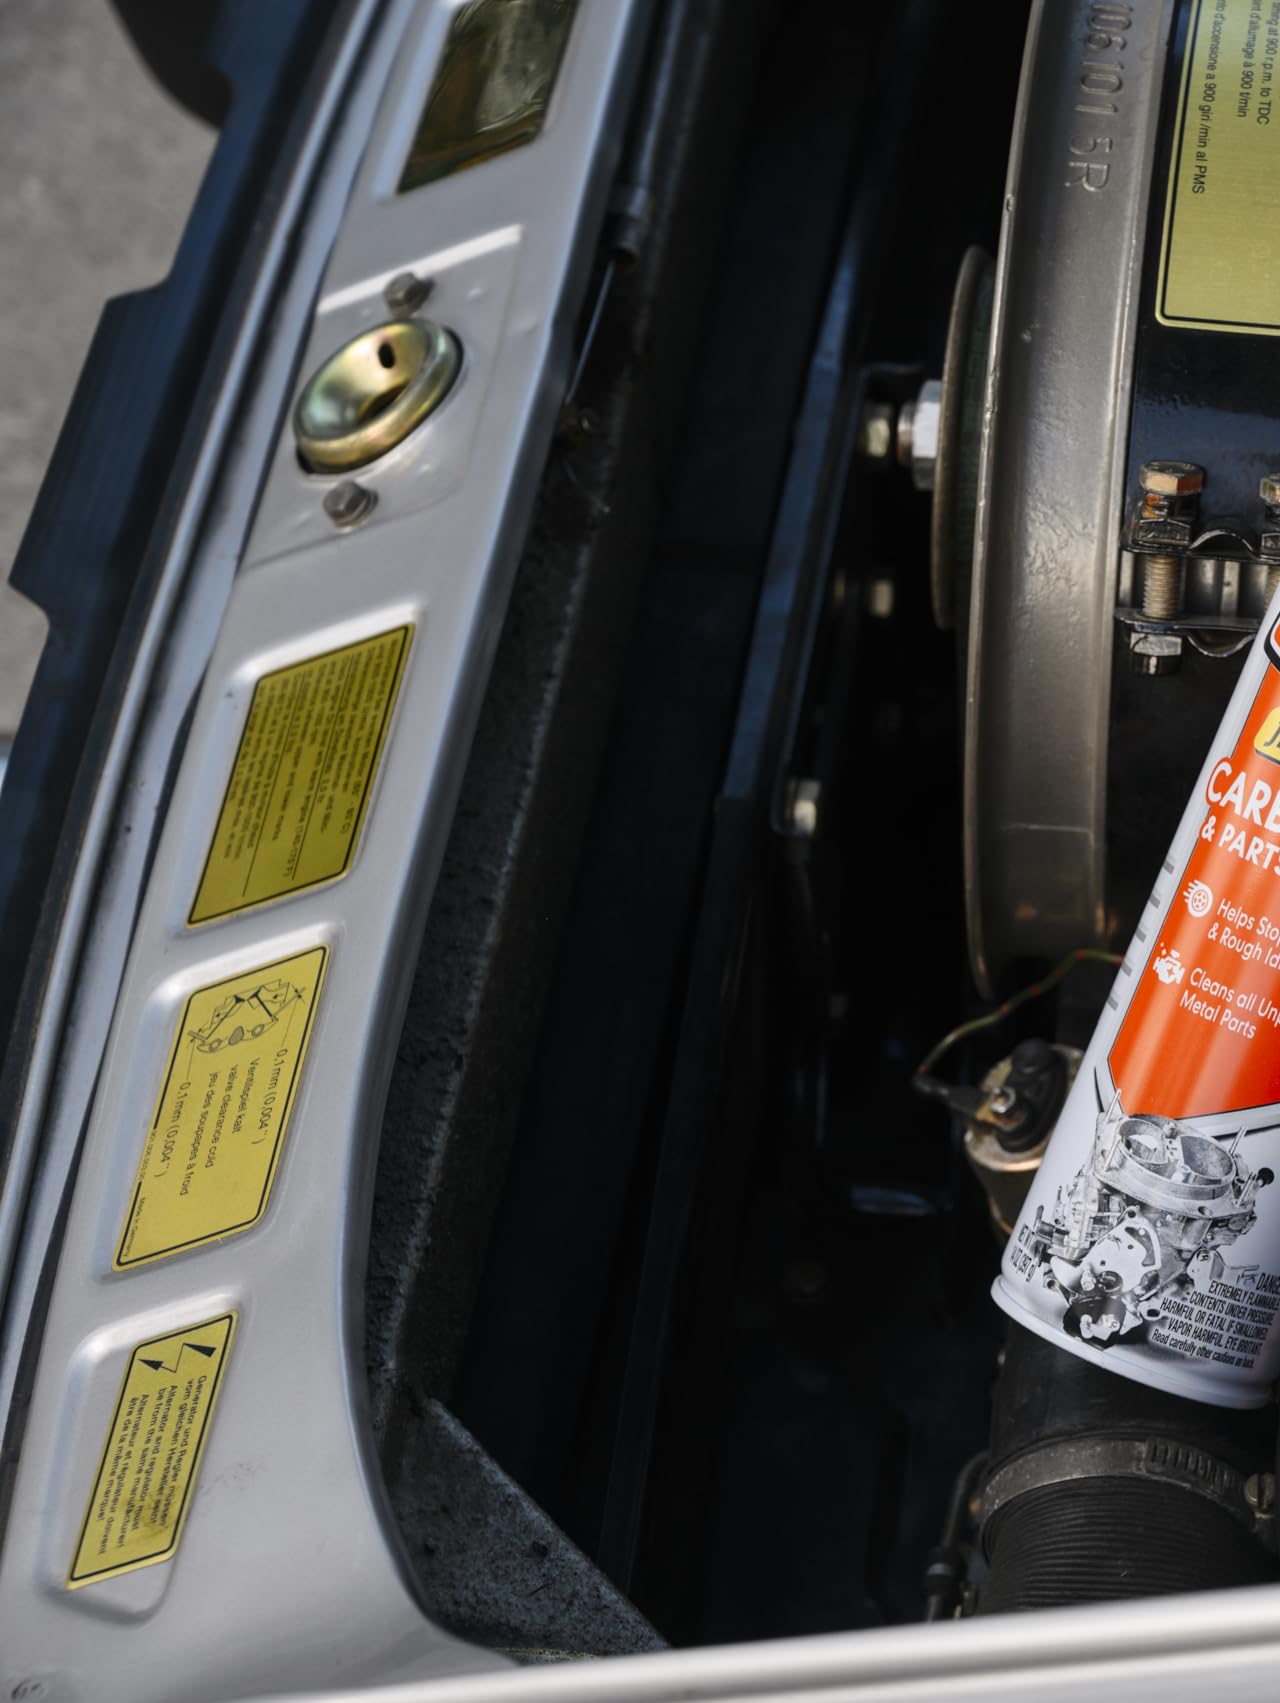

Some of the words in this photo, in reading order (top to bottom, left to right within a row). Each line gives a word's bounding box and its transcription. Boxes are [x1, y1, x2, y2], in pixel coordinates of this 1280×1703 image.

[1264, 38, 1278, 54] 900
[1202, 82, 1217, 102] 900
[1239, 70, 1254, 89] 900
[1259, 87, 1271, 97] to
[1256, 100, 1271, 125] TDC
[1195, 151, 1208, 161] al
[1191, 164, 1207, 194] PMS
[1199, 814, 1219, 842] &
[1216, 897, 1255, 930] Helps
[1206, 922, 1220, 941] &
[1219, 926, 1264, 960] Rough
[1188, 966, 1235, 1002] Cleans
[1236, 988, 1257, 1010] all
[1179, 989, 1220, 1023] Metal
[1219, 1010, 1257, 1039] Parts
[206, 1070, 219, 1088] jeu
[223, 1063, 240, 1093] valve
[235, 1057, 260, 1113] Ventilspiel
[202, 1088, 215, 1109] des
[210, 1092, 232, 1144] clearance
[231, 1112, 246, 1134] kalt
[186, 1110, 209, 1161] soupapes
[203, 1143, 219, 1169] cold
[178, 1171, 194, 1197] froid
[1189, 1290, 1226, 1313] CONTENTS
[1224, 1302, 1248, 1320] UNDER
[1208, 1280, 1250, 1303] EXTREMELY
[1159, 1297, 1194, 1320] HARMFUL
[1194, 1309, 1206, 1323] OR
[1205, 1313, 1227, 1330] FATAL
[1225, 1319, 1235, 1332] IF
[1152, 1329, 1170, 1344] Read
[1168, 1335, 1198, 1355] carefully
[1195, 1344, 1214, 1359] other
[1167, 1317, 1192, 1336] VAPOR
[1224, 1335, 1238, 1350] EYE
[155, 1387, 167, 1401] be
[182, 1378, 194, 1400] vom
[185, 1374, 207, 1425] Generator
[125, 1396, 139, 1417] être
[126, 1392, 149, 1449] Alternateur
[149, 1402, 162, 1426] from
[157, 1383, 178, 1433] Alternator
[121, 1417, 132, 1432] de
[143, 1427, 156, 1445] the
[168, 1401, 189, 1445] gleichen
[179, 1426, 194, 1448] und
[117, 1433, 128, 1443] la
[151, 1434, 164, 1454] and
[108, 1444, 125, 1477] même
[123, 1449, 133, 1460] et
[135, 1446, 149, 1475] same
[168, 1448, 187, 1483] Regler
[137, 1455, 158, 1502] regulator
[156, 1446, 177, 1496] Hersteller
[107, 1461, 130, 1514] régulateur
[130, 1503, 145, 1531] must
[97, 1515, 116, 1555] doivent
